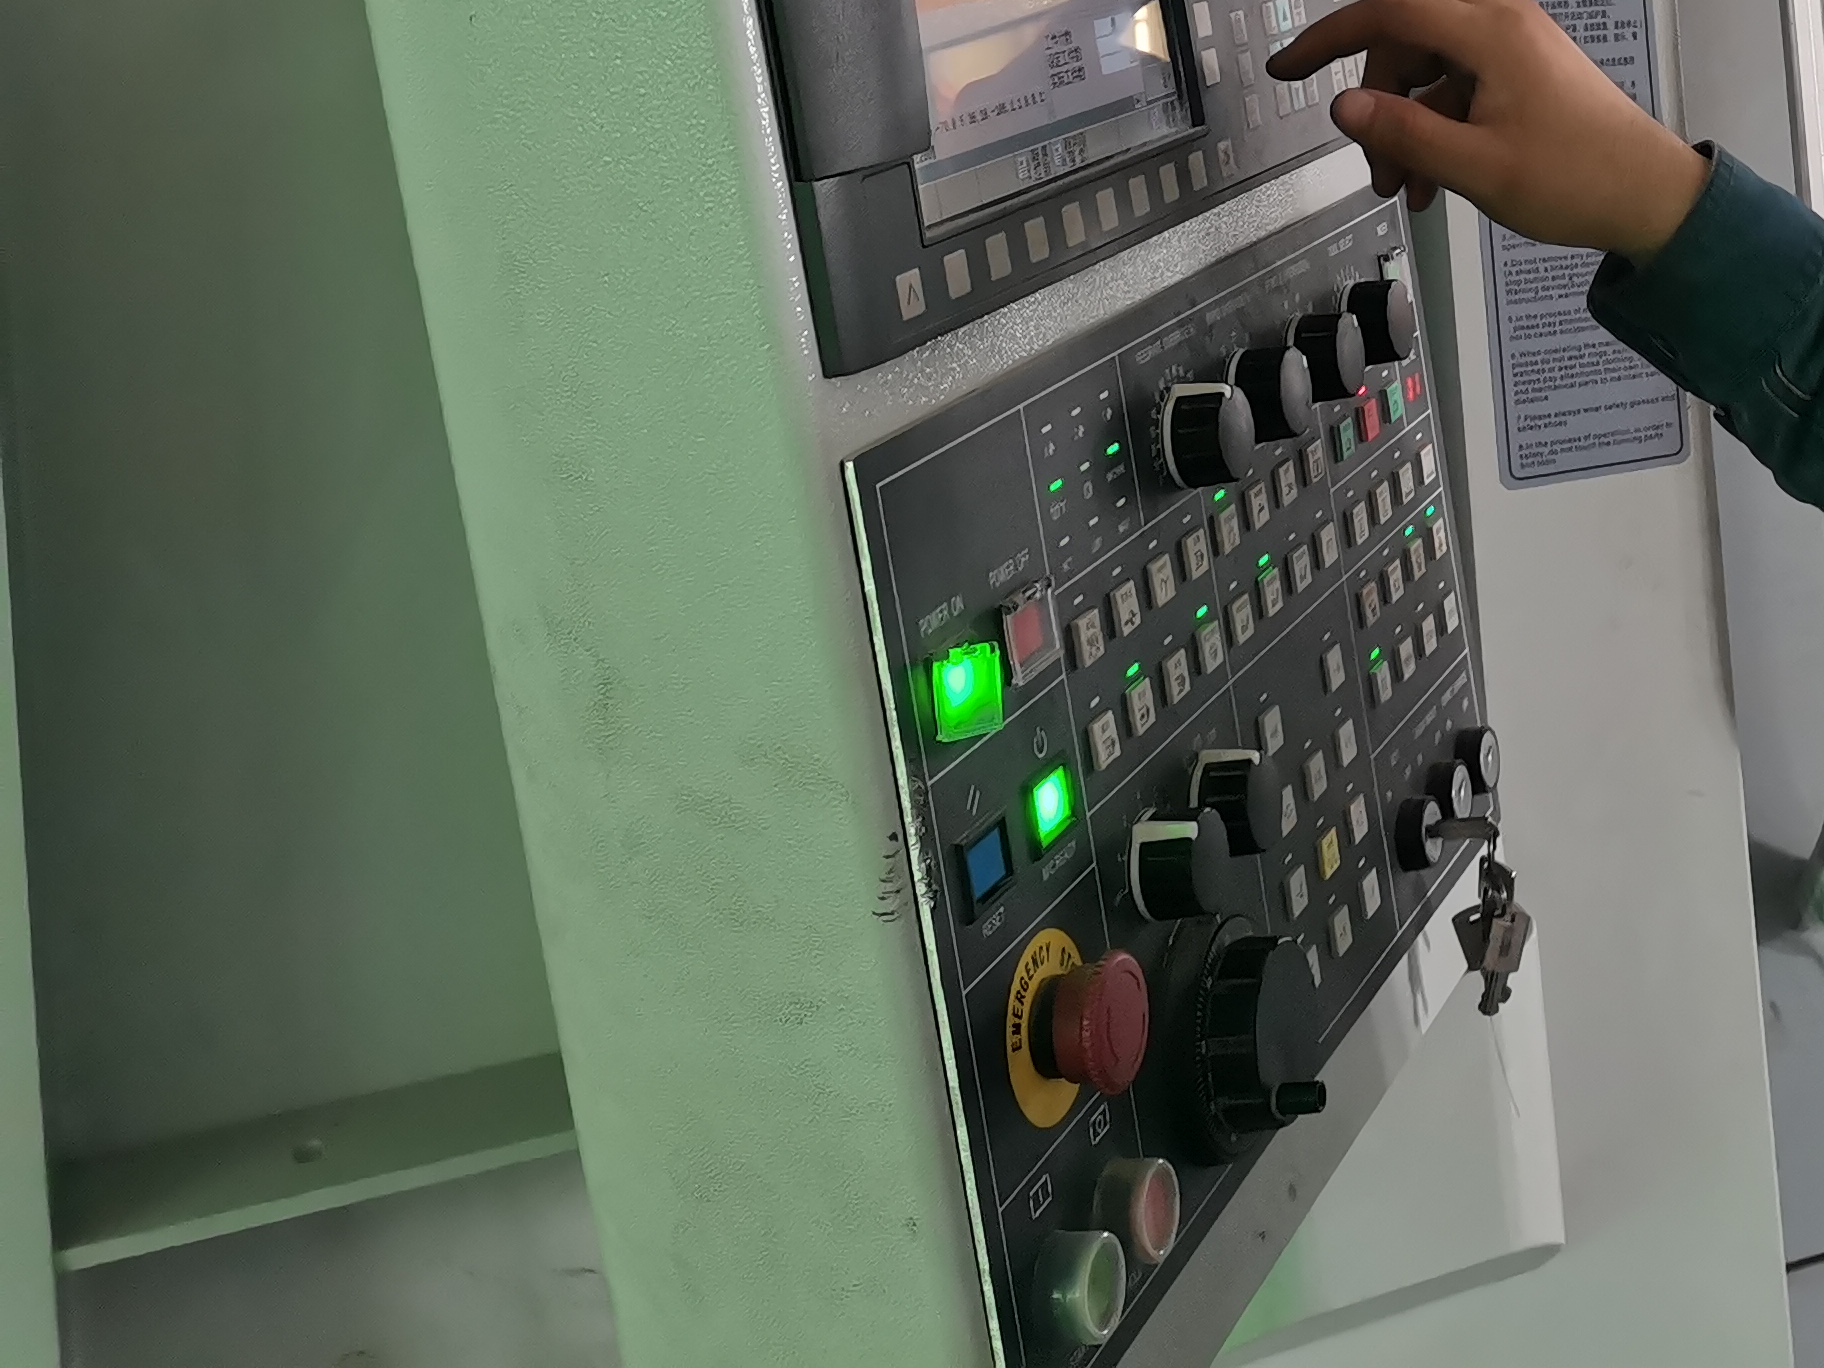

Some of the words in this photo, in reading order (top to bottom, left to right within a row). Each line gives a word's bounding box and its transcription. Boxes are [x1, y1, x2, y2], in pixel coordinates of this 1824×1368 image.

[918, 601, 949, 638] POWER
[950, 592, 964, 617] ON
[1010, 940, 1051, 1053] EMERGENCY
